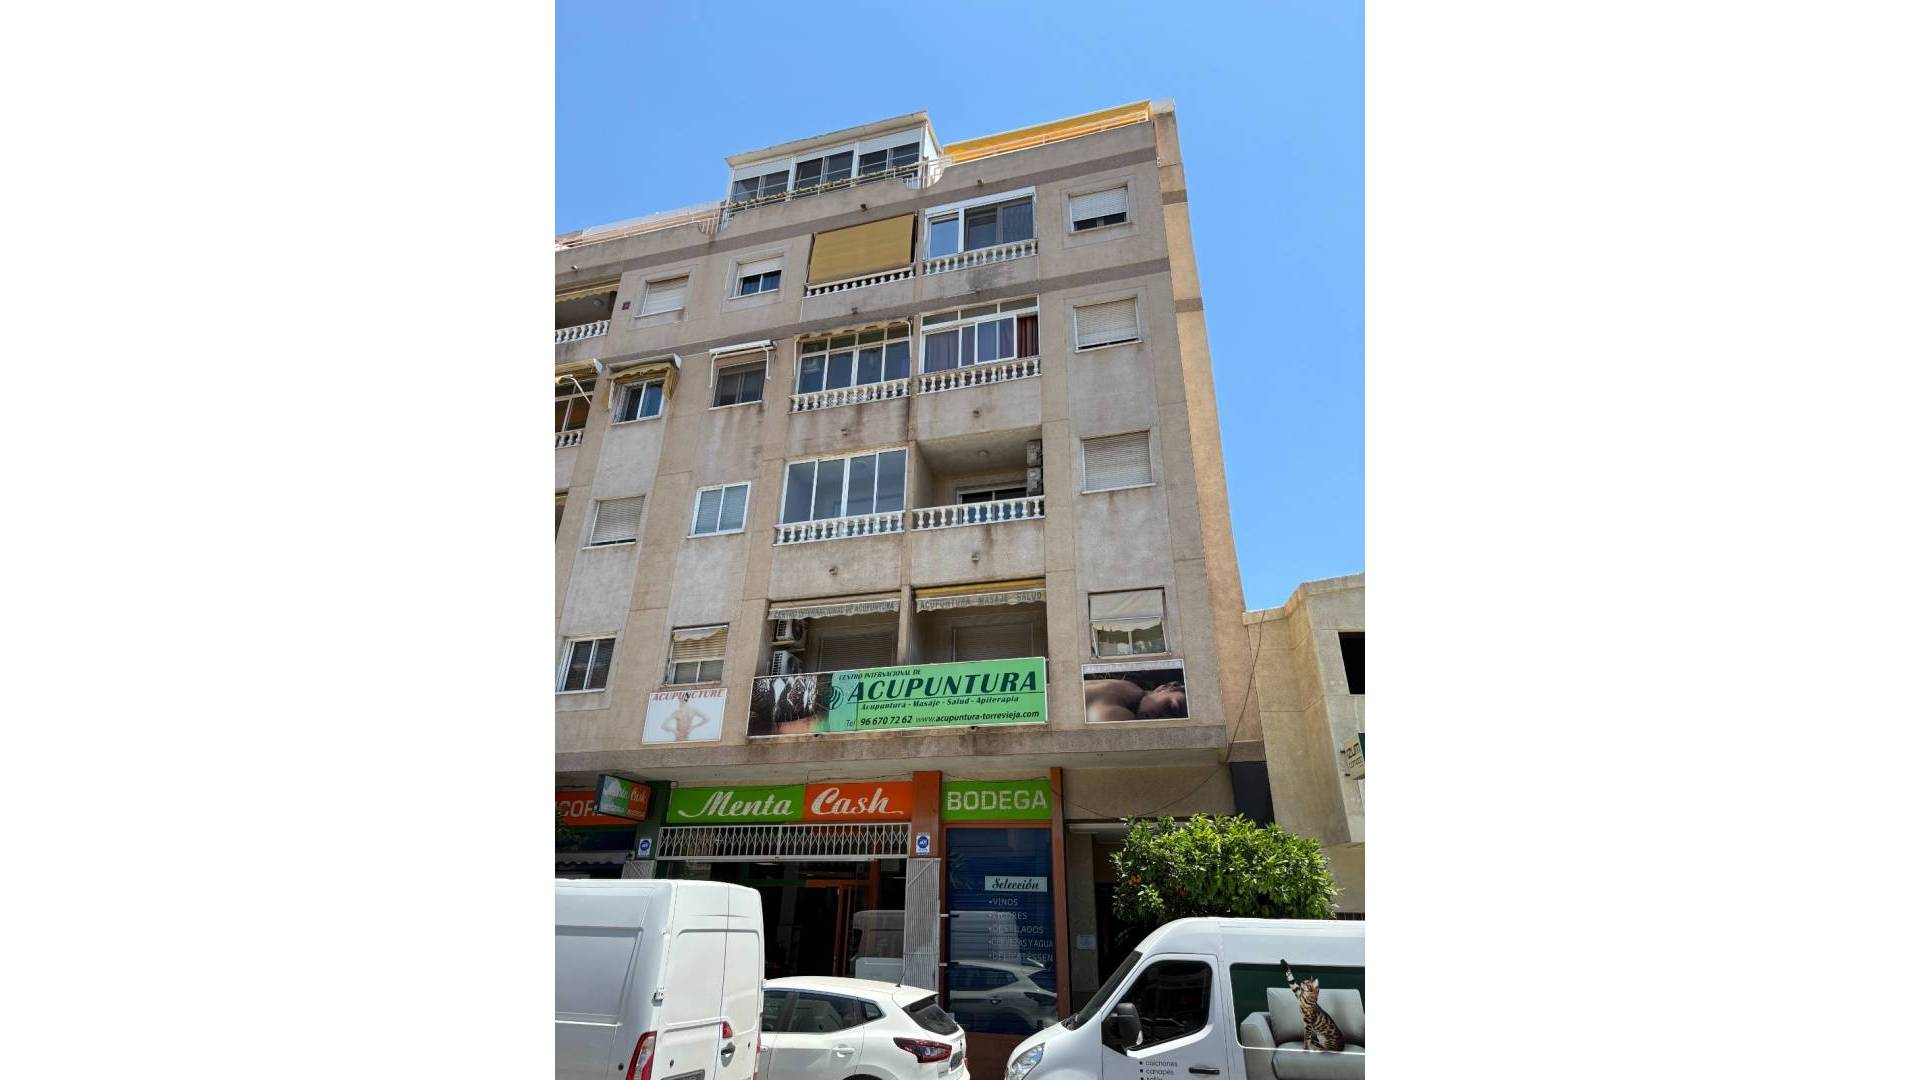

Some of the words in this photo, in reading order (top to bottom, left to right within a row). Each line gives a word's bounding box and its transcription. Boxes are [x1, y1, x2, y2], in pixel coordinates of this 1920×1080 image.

[838, 672, 863, 680] CENTRO
[864, 669, 911, 679] INTERNACIONAL
[847, 671, 1037, 702] ACUPUNTURA
[652, 689, 722, 701] ACUPUNCTURE
[862, 702, 906, 711] Acupuntura
[913, 700, 940, 708] Masaje
[947, 697, 970, 706] Salud
[976, 695, 1019, 705] Apiterapia
[860, 718, 871, 726] 96
[872, 716, 888, 725] 670
[889, 716, 900, 724] 72
[901, 715, 913, 724] 62
[915, 710, 1040, 723] www.acupuntura-torrevieja.com
[677, 791, 795, 818] Menta
[810, 787, 904, 815] Cash
[946, 789, 1048, 812] BODEGA
[992, 877, 1040, 890] Selección
[992, 897, 1019, 906] VINOS
